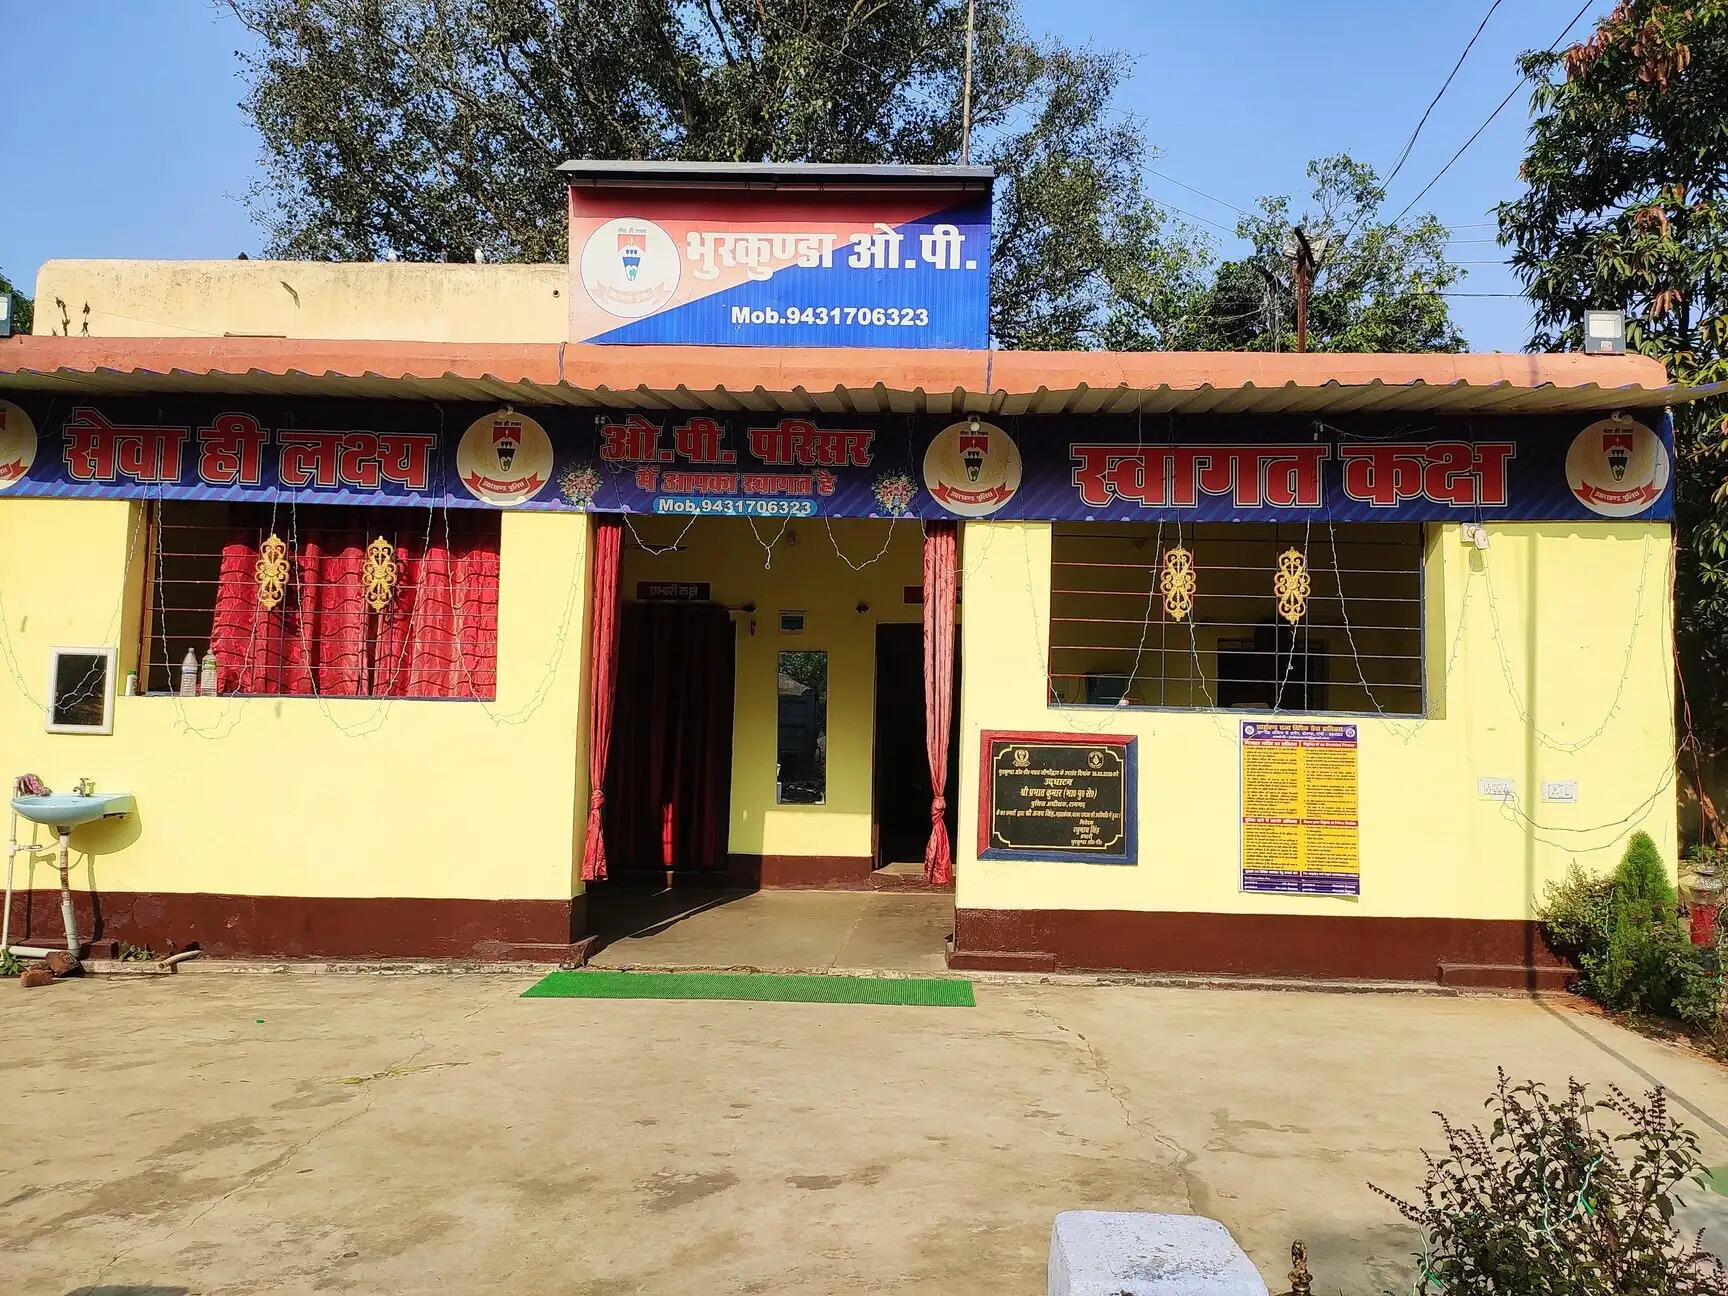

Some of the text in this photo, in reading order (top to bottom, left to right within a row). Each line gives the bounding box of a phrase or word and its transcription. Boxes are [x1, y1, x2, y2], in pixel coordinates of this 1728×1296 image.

[685, 222, 978, 281] भुरकुण्डा ओ.पी.
[731, 306, 929, 326] Mob.9431706323
[63, 407, 437, 491] सेवा ही लक्ष्य
[747, 419, 875, 467] परिसर
[635, 466, 838, 496] में आपका स्वागत है
[1069, 439, 1517, 511] स्वागत कक्ष
[657, 497, 813, 515] Mob.9431706323
[1029, 788, 1046, 797] प्रभात
[1046, 788, 1063, 799] कुमार
